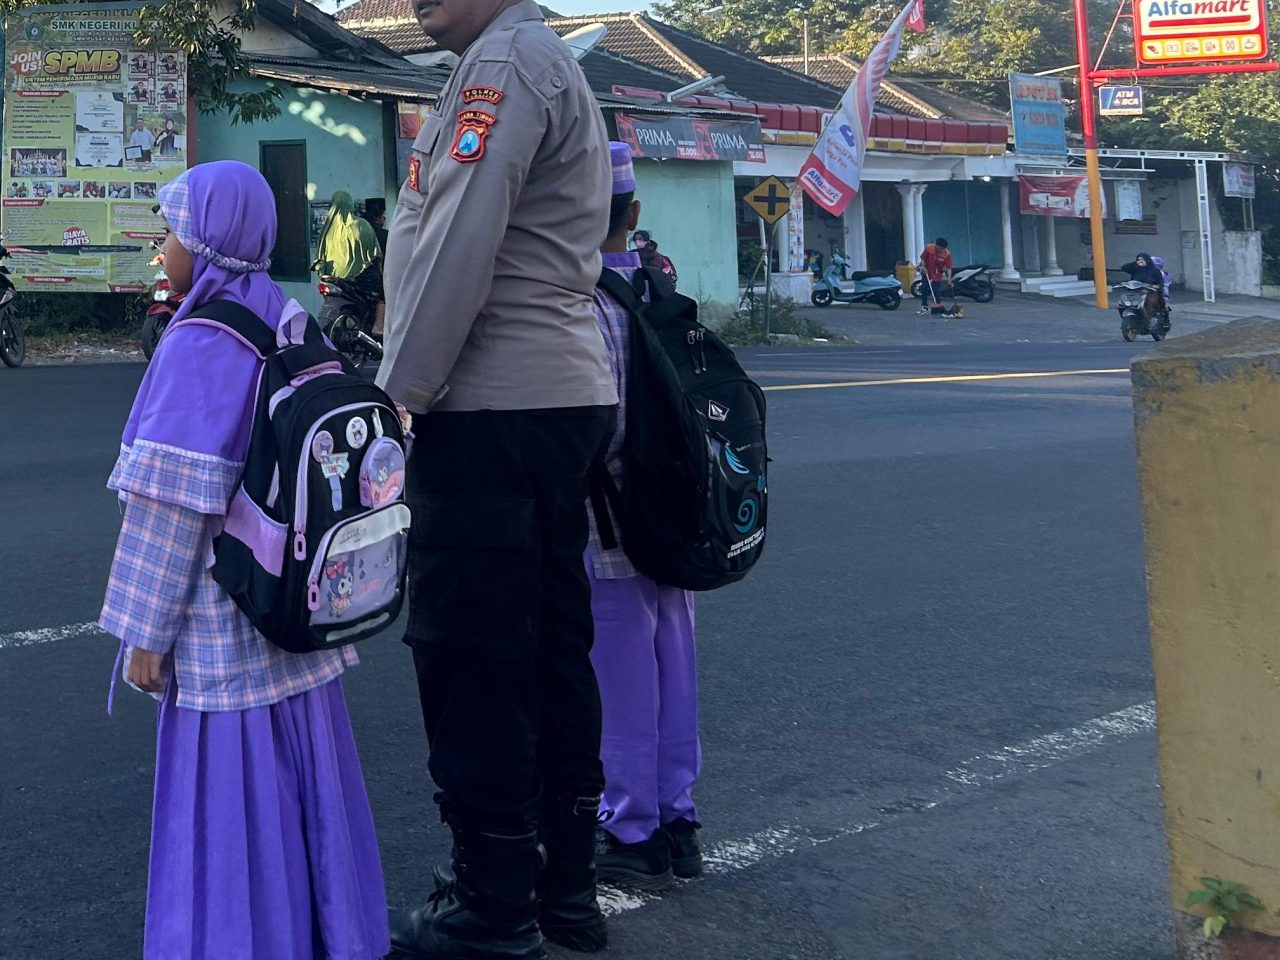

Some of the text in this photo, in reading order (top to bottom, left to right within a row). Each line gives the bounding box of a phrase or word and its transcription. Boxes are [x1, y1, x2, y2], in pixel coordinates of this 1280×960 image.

[52, 21, 76, 30] SMK
[80, 21, 120, 30] NEGERI
[10, 51, 42, 65] JOIN
[44, 49, 122, 74] SPMB
[21, 60, 43, 72] US!
[636, 128, 676, 146] PRIMA
[710, 132, 747, 150] PRIMA
[807, 169, 839, 200] Alfamart
[61, 236, 90, 246] GRATIS
[63, 230, 86, 240] BIAYA
